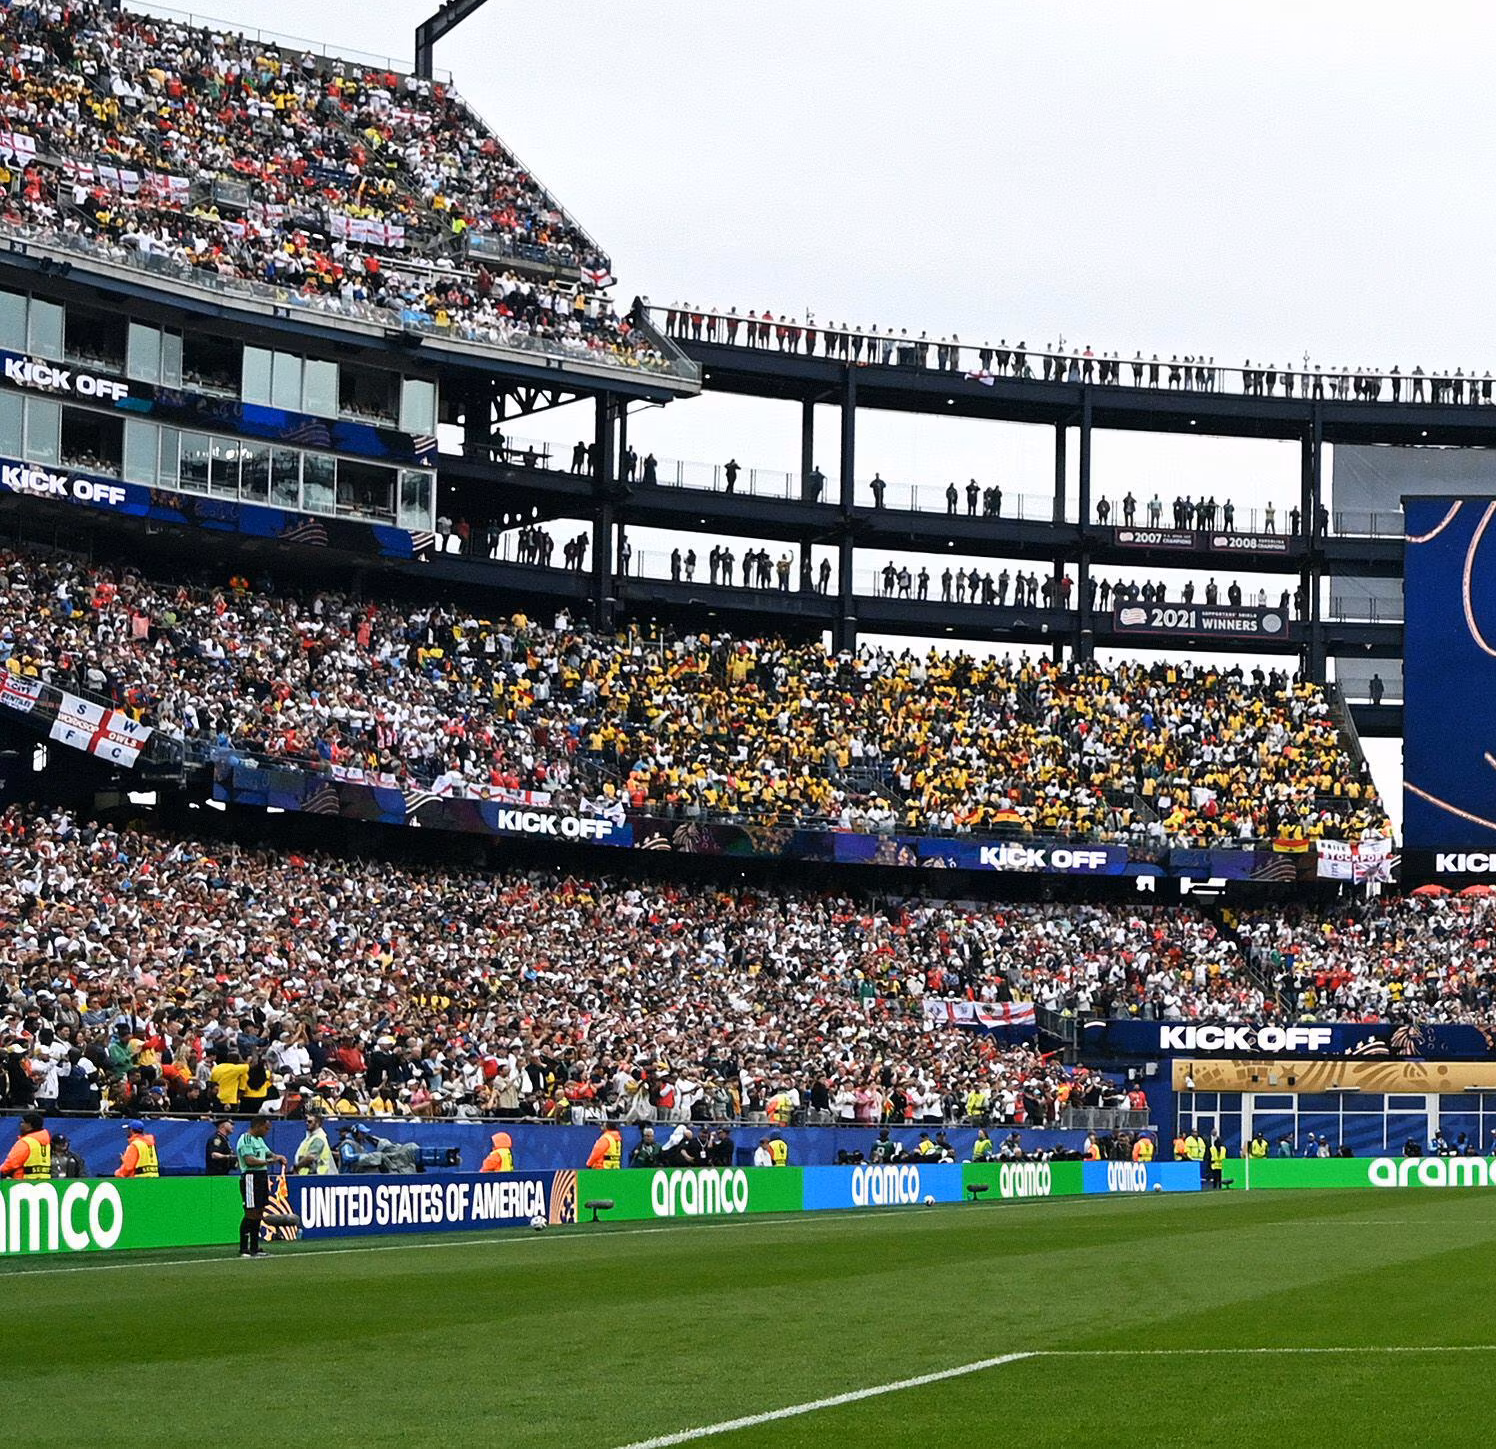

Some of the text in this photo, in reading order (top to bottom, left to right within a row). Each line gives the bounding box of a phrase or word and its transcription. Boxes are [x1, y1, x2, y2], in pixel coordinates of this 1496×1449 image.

[6, 359, 128, 400] KICK OFF
[3, 466, 125, 504] KICK OFF
[1134, 532, 1161, 543] 2007
[1229, 537, 1257, 548] 2008
[1151, 608, 1196, 628] 2021
[1202, 619, 1258, 632] WINNERS
[76, 704, 87, 715] S
[65, 729, 76, 740] F
[123, 720, 139, 733] W
[108, 732, 137, 747] OWLS
[111, 747, 122, 758] C
[499, 810, 612, 838] KICK OFF
[981, 846, 1106, 868] KICK OFF
[1161, 1026, 1331, 1052] KICK OFF
[851, 1165, 920, 1206] aramco
[999, 1162, 1051, 1198] aramco
[1107, 1161, 1147, 1192] aramco
[652, 1168, 749, 1216] aramco
[0, 1182, 123, 1252] mco
[301, 1181, 546, 1229] UNITED STATES OF AMERICA
